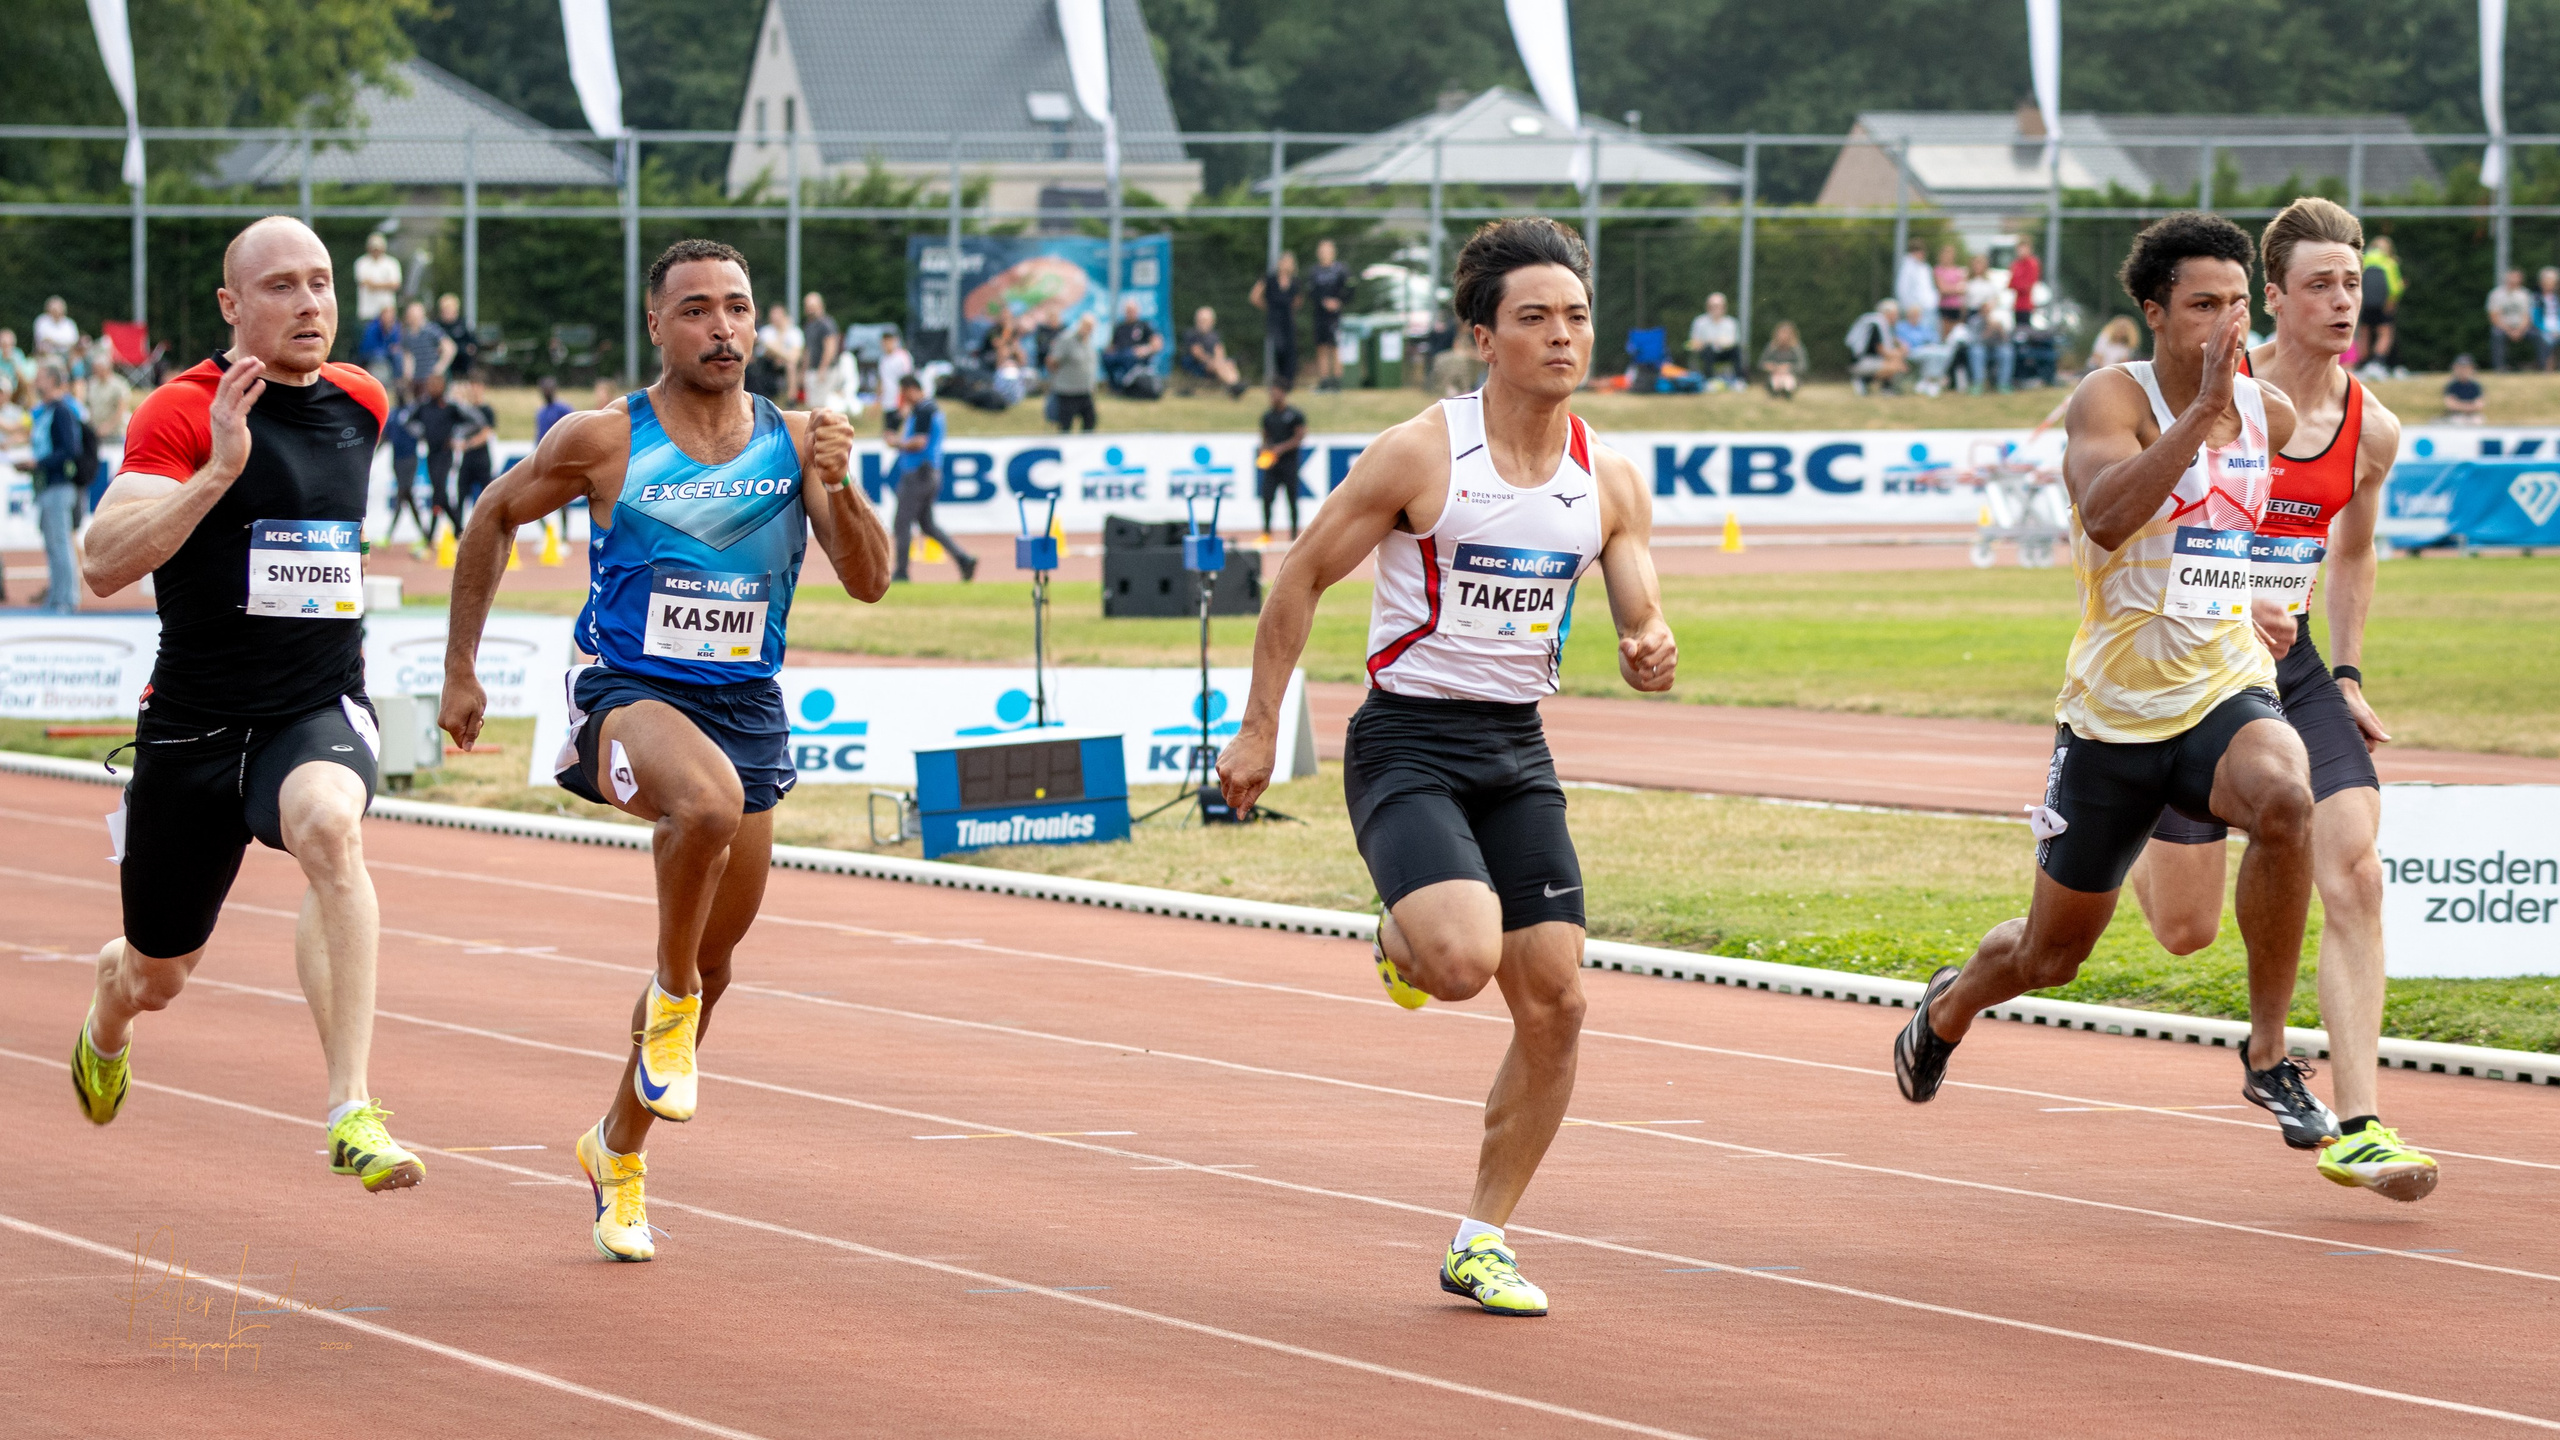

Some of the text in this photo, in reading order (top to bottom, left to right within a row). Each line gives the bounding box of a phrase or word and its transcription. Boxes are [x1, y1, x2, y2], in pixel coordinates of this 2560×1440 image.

[1654, 443, 1864, 496] KBC
[2228, 458, 2257, 468] Allianz
[639, 478, 792, 502] EXCELSIOR
[1082, 483, 1145, 498] KBC
[2251, 542, 2317, 562] BC-NACHT
[268, 565, 351, 583] SNYDERS
[2179, 567, 2246, 589] CAMARA
[2249, 575, 2307, 588] ERKHOFS
[1458, 581, 1554, 612] TAKEDA
[662, 604, 754, 633] KASMI
[790, 743, 866, 772] BC
[1148, 745, 1222, 771] KB
[956, 811, 1096, 847] TimeTronics
[2424, 889, 2559, 924] zolder
